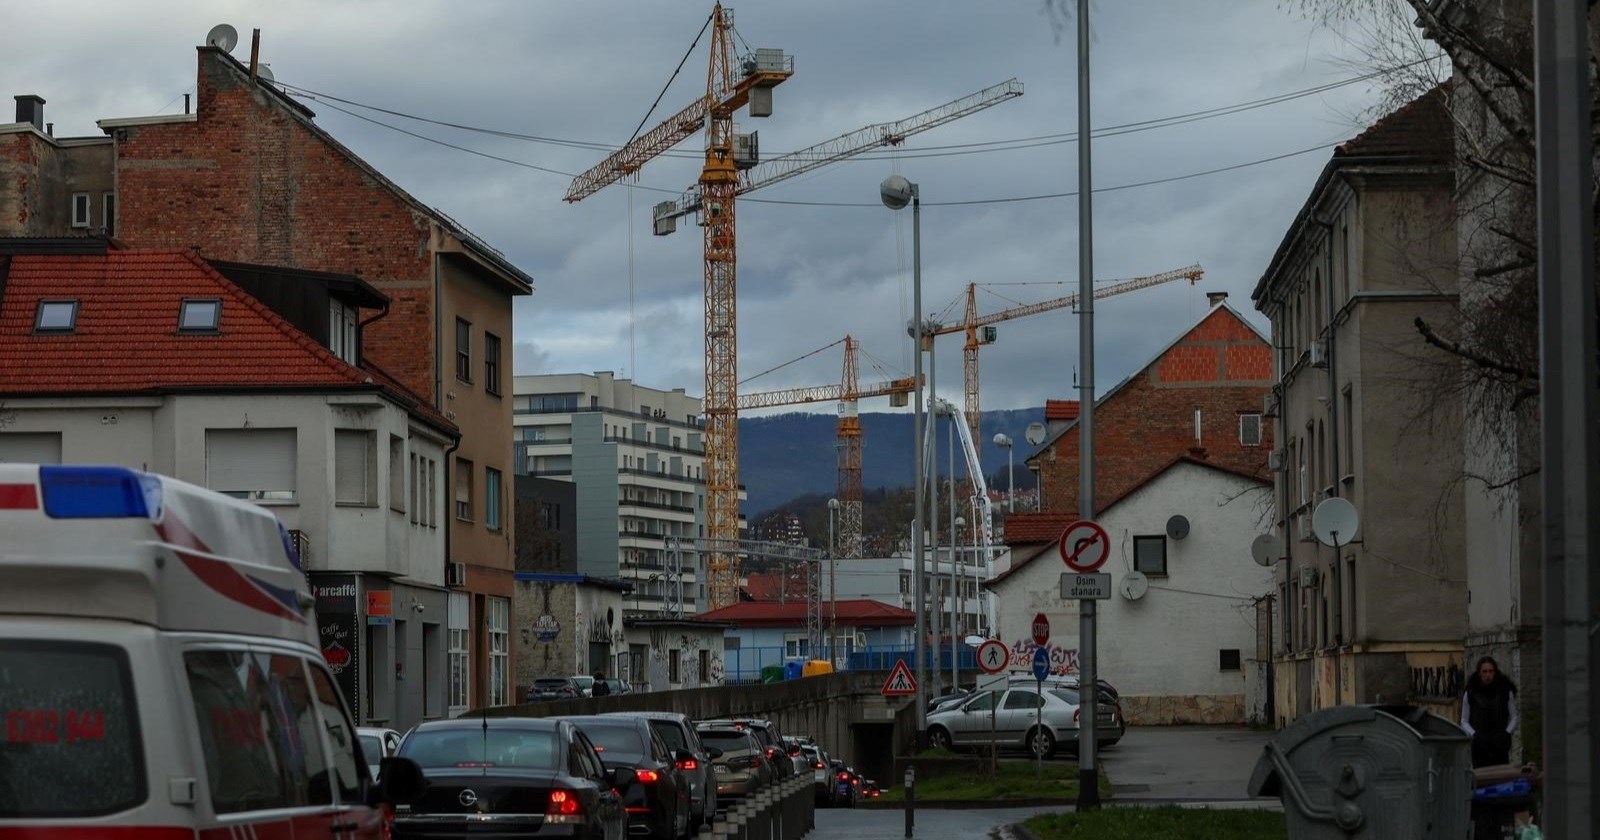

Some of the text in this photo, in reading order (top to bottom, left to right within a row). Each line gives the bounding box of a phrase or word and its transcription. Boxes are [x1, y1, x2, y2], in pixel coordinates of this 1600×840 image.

[1076, 576, 1096, 585] Osim
[1070, 586, 1102, 596] stanara
[1033, 623, 1049, 637] STOP
